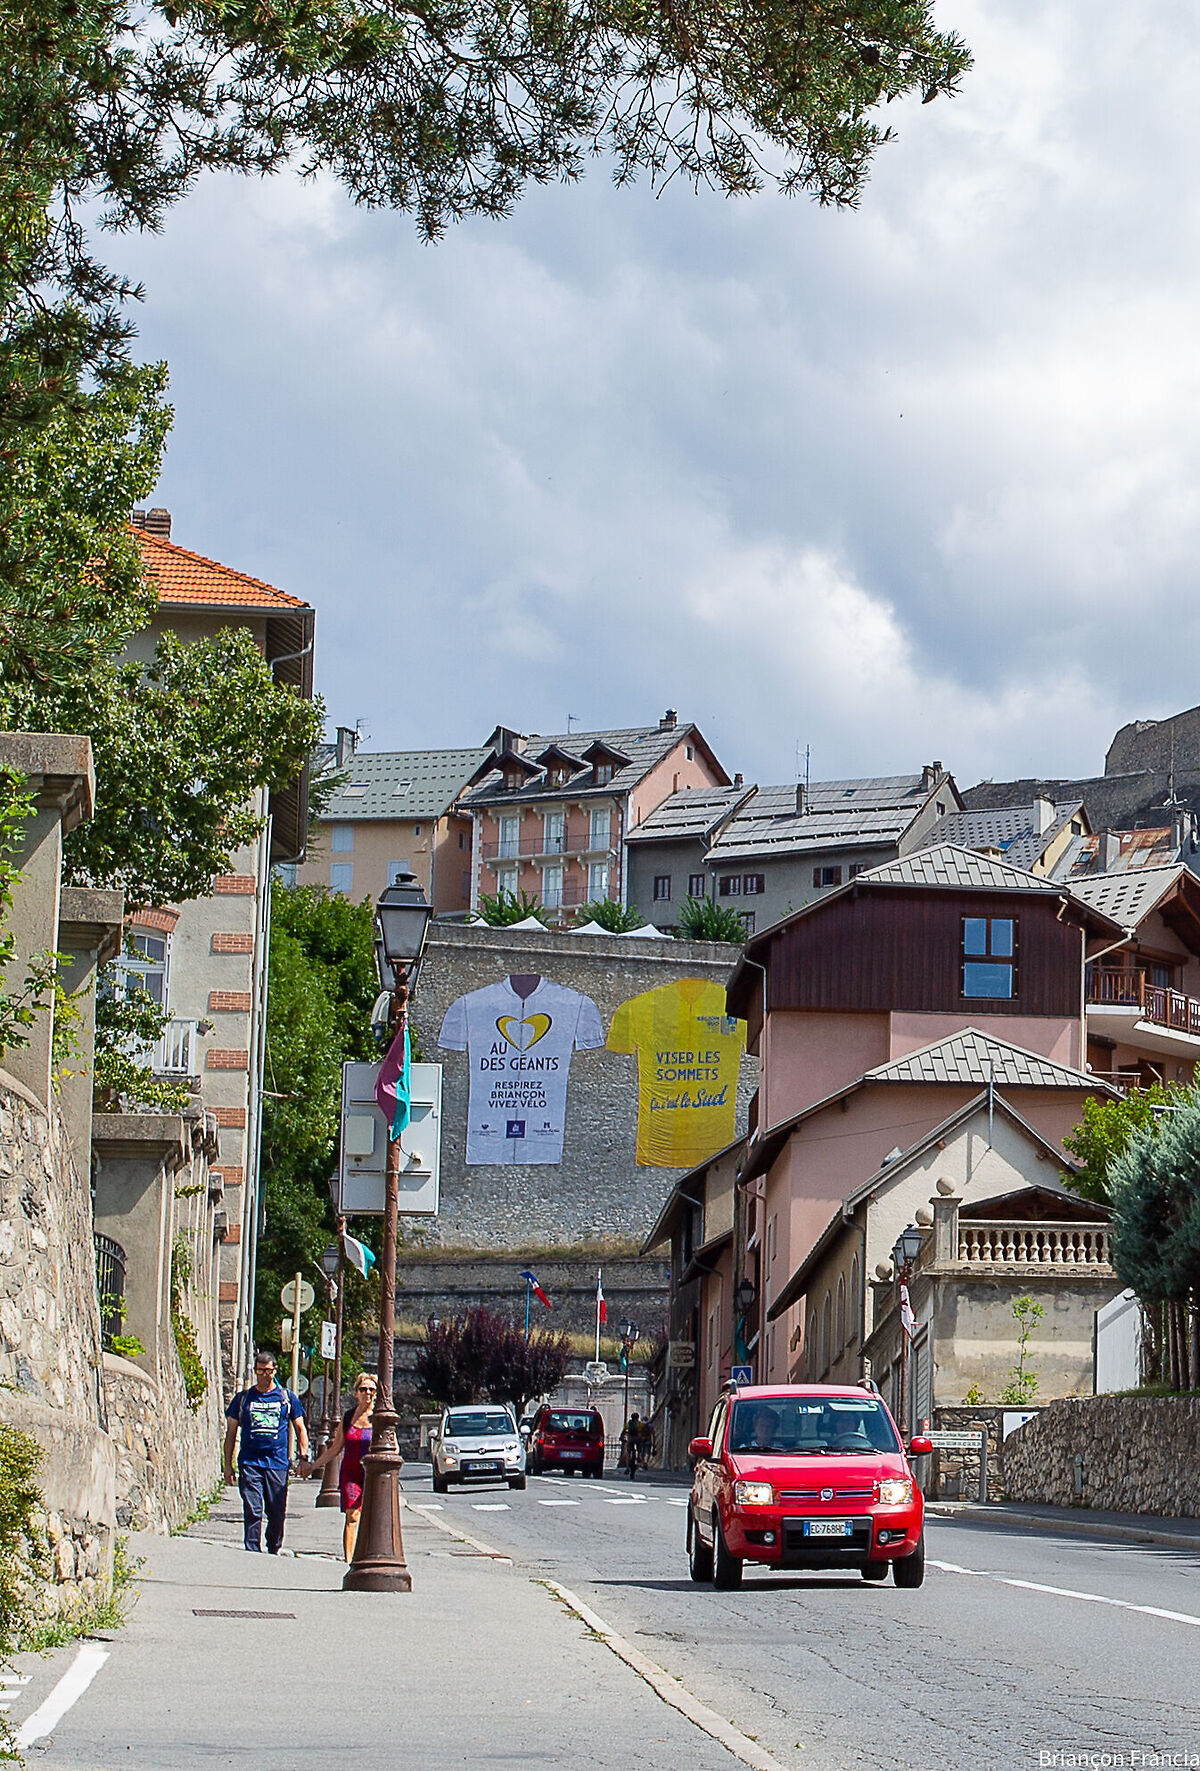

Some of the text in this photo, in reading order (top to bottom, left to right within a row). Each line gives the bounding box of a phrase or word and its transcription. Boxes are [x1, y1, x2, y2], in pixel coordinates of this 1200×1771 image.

[490, 1042, 508, 1055] AU
[480, 1053, 559, 1071] DES GÉANTS
[656, 1050, 721, 1064] VISER LES
[656, 1068, 719, 1081] SOMMETS
[494, 1081, 543, 1090] RESPIREZ
[491, 1090, 546, 1100] BRIANÇON
[692, 1084, 729, 1108] Sud
[488, 1099, 547, 1108] VIVEZ VÉLO
